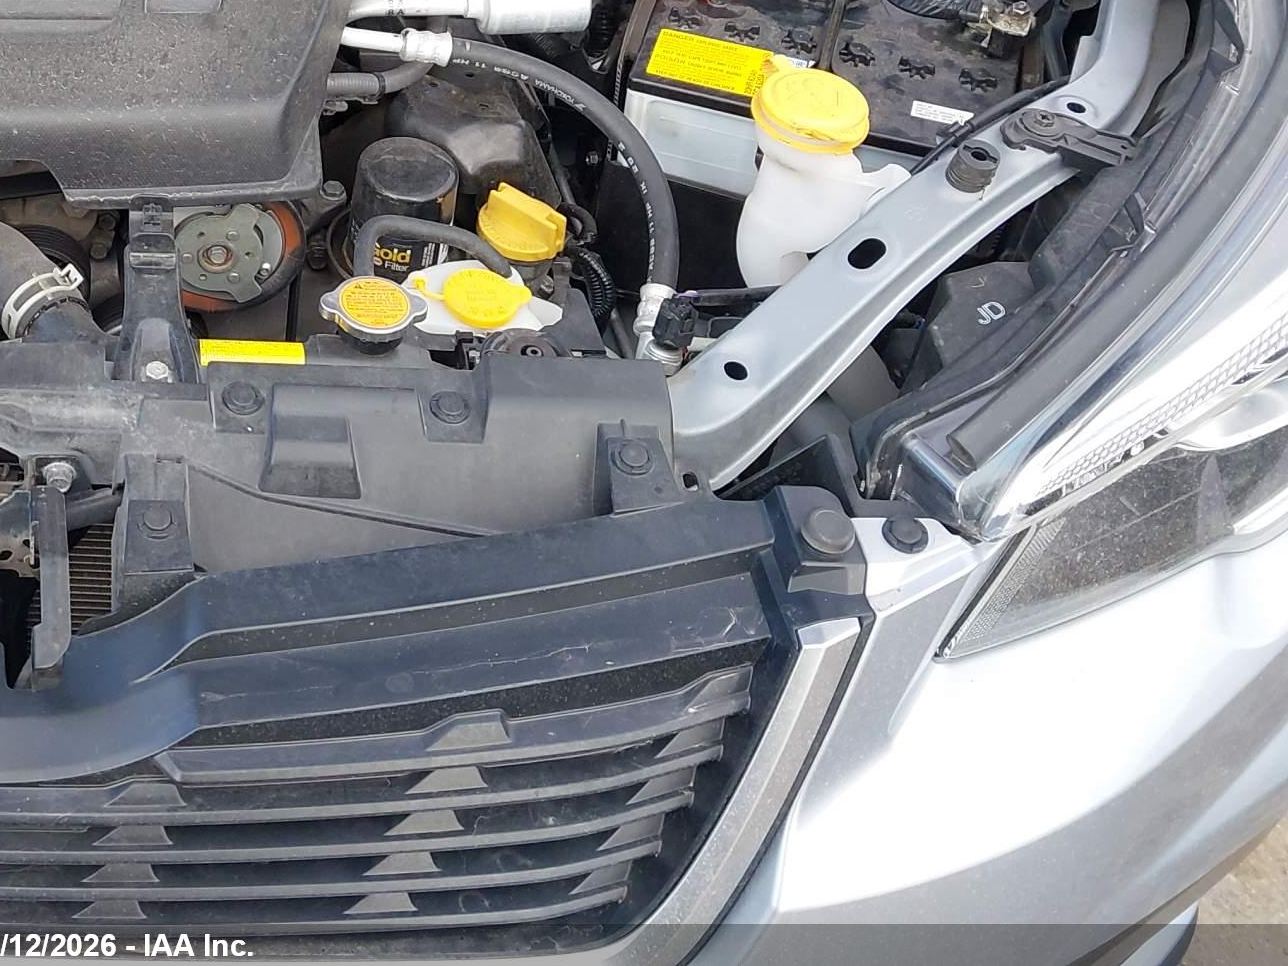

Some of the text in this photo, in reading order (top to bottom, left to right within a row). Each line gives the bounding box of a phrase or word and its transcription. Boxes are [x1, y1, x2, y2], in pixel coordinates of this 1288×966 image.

[535, 79, 575, 104] YOKOHAMA
[384, 260, 410, 272] Filter
[976, 301, 1007, 326] JD
